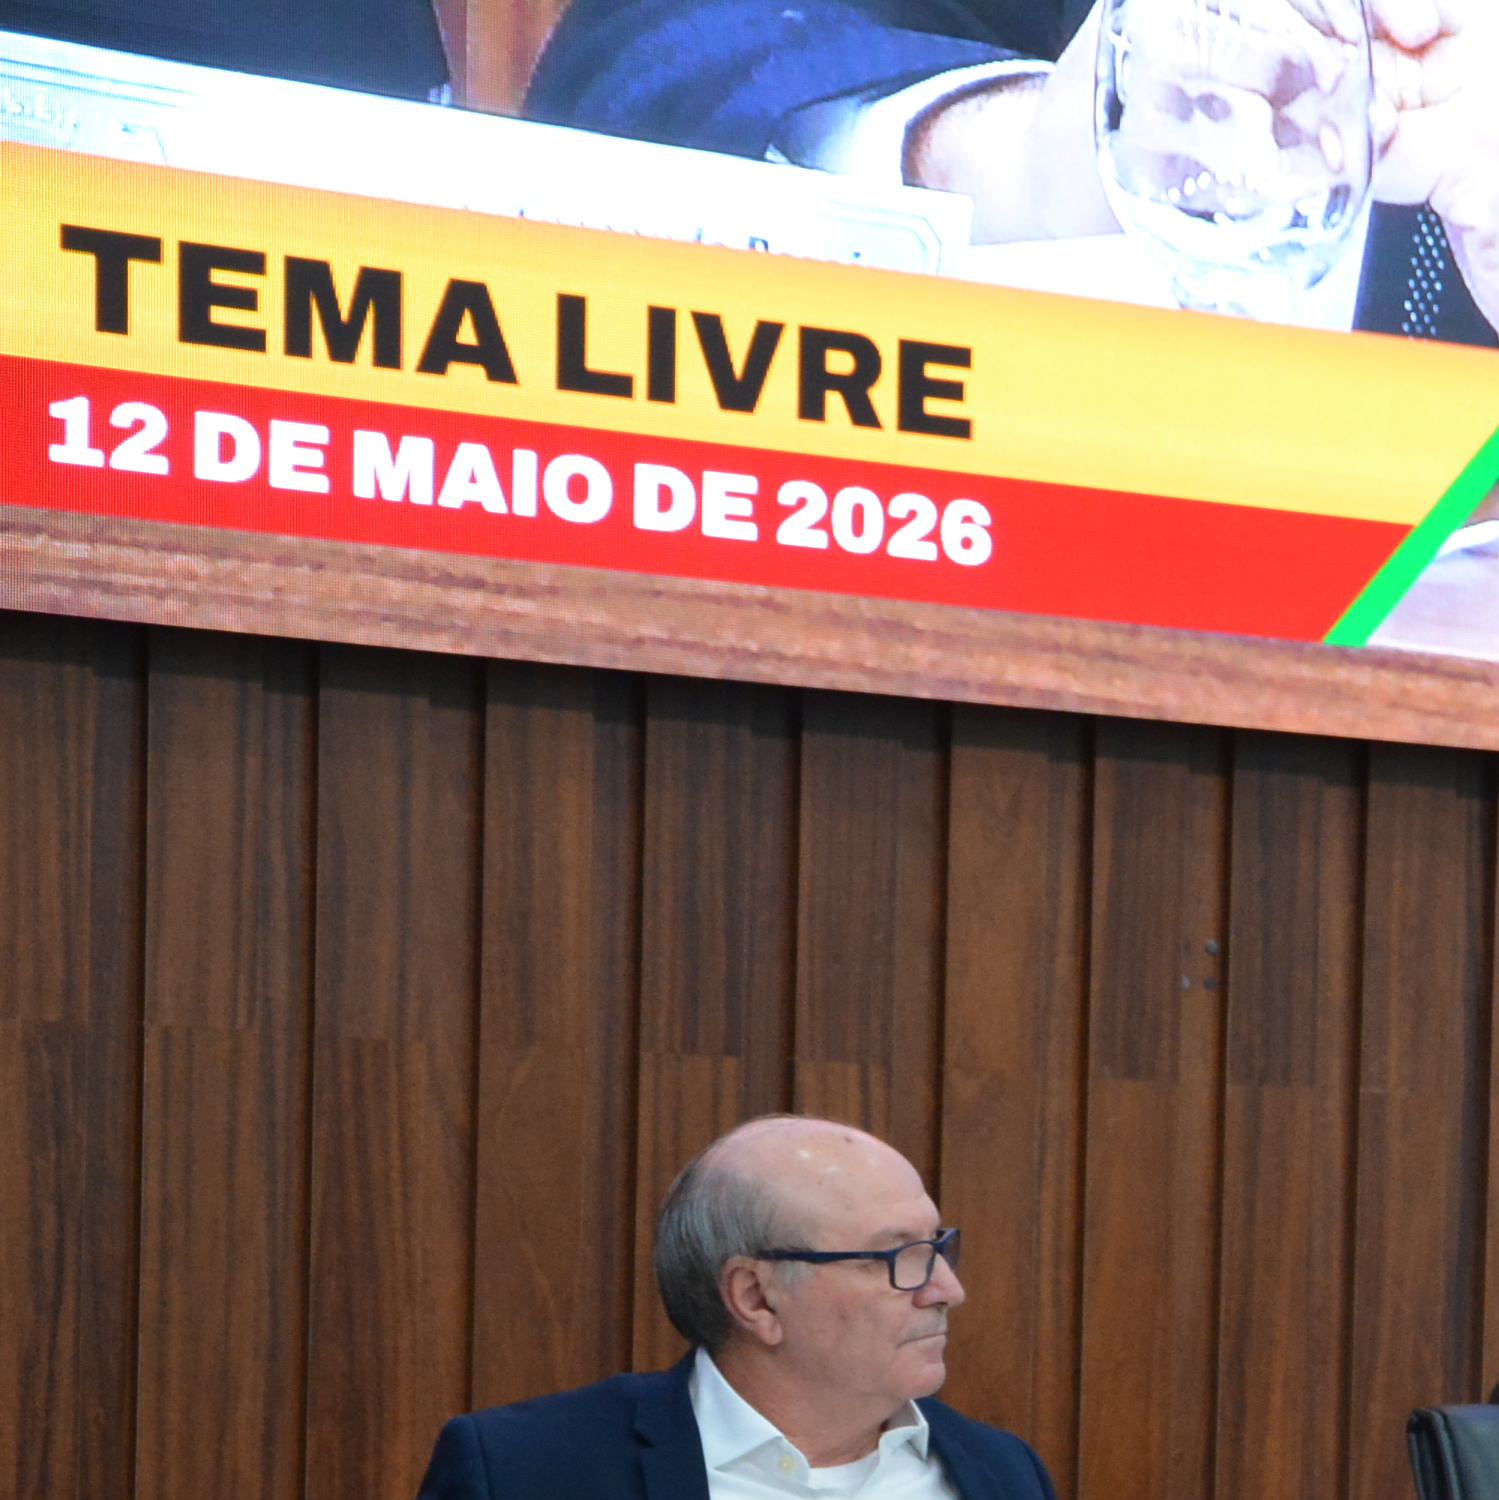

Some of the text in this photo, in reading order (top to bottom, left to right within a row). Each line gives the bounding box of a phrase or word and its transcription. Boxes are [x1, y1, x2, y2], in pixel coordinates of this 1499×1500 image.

[60, 223, 518, 385] TEMA
[556, 293, 973, 440] LIVRE
[47, 394, 994, 567] 12 DE MAIO DE 2026
